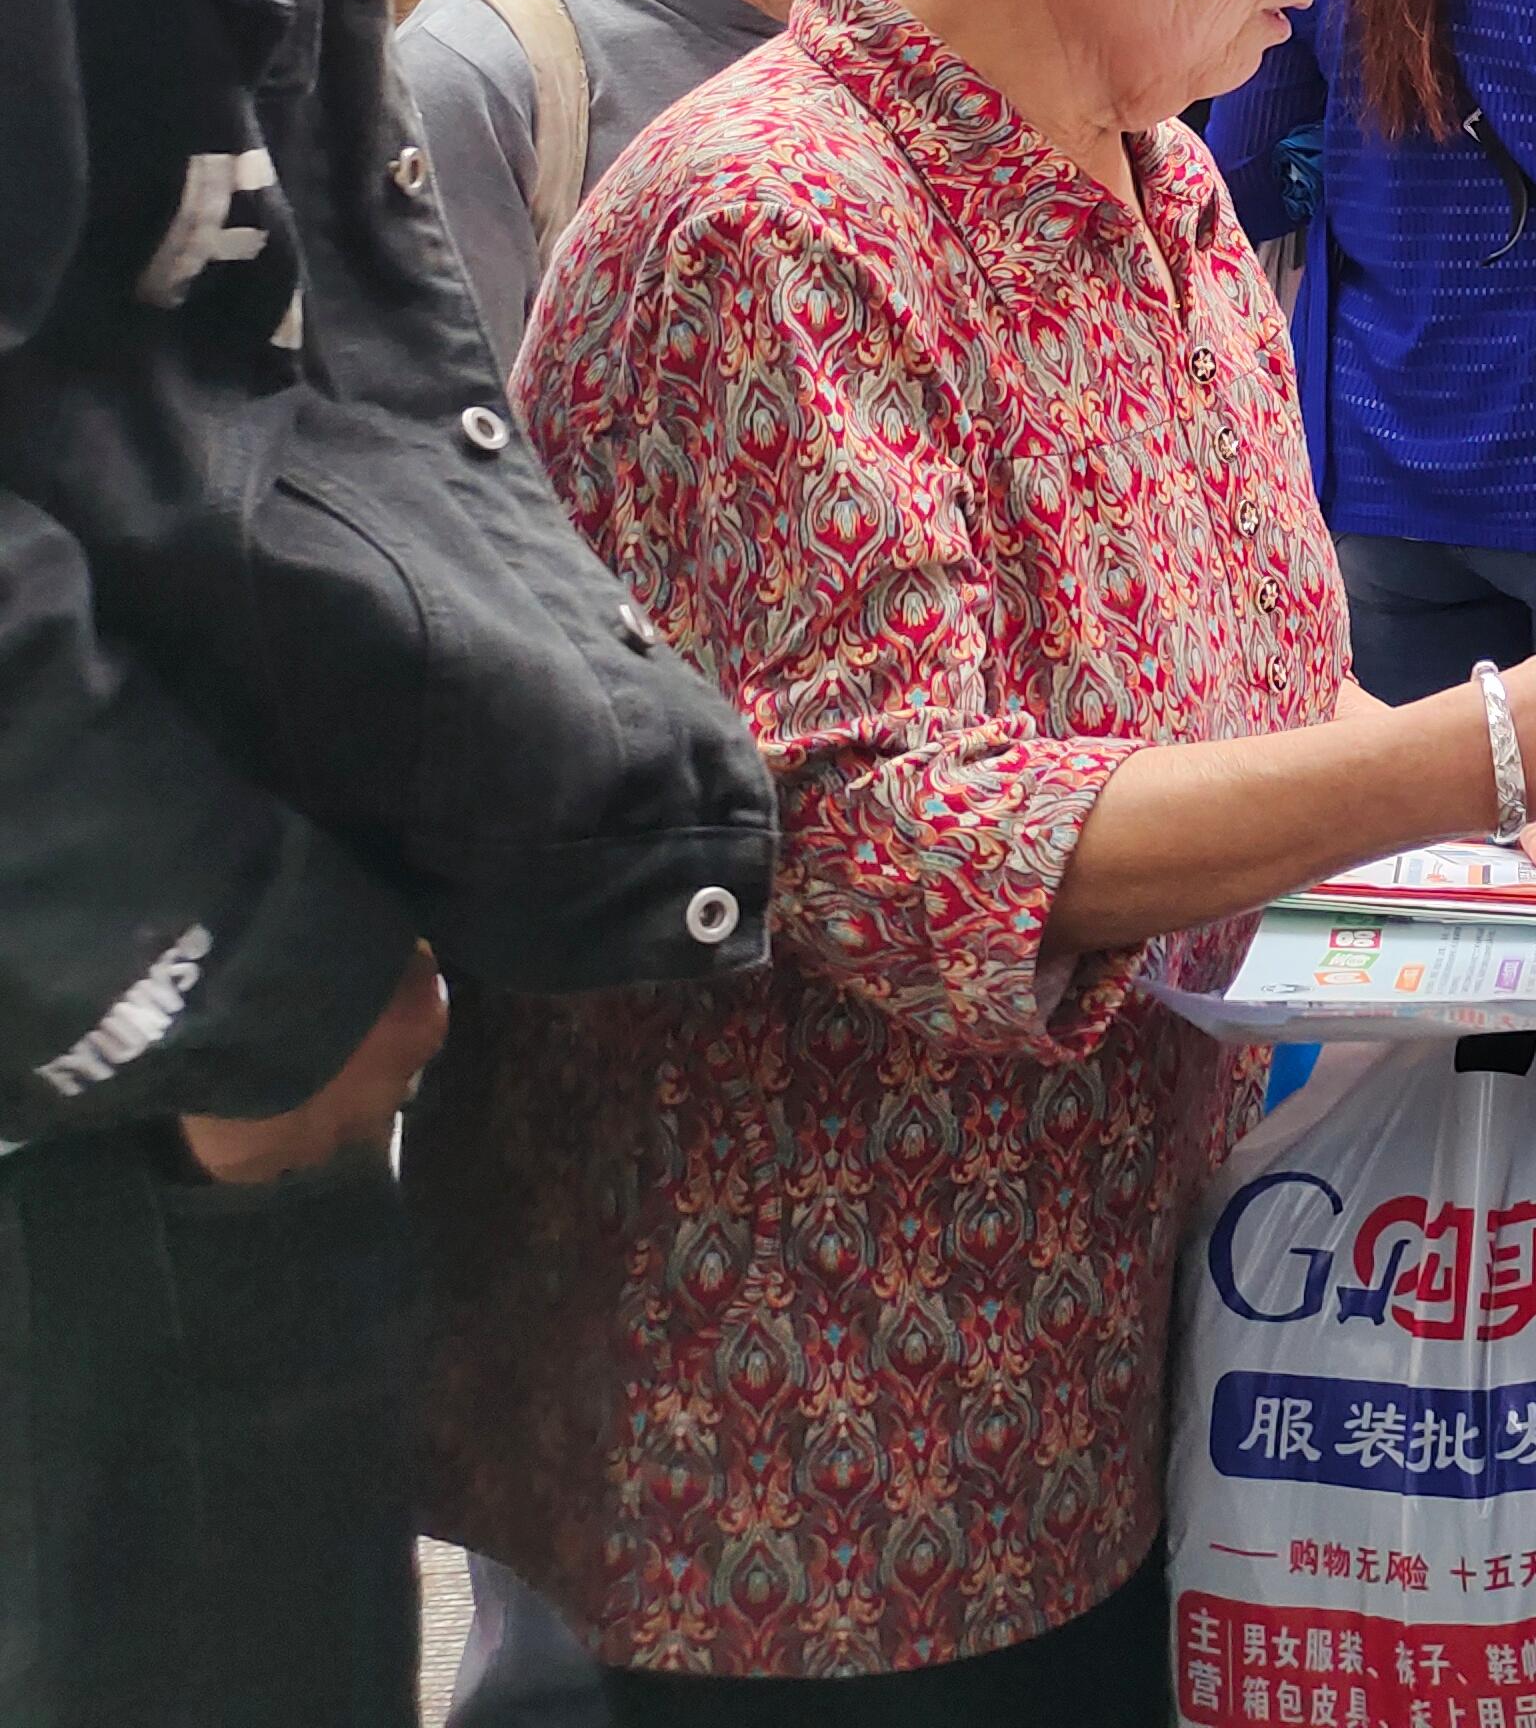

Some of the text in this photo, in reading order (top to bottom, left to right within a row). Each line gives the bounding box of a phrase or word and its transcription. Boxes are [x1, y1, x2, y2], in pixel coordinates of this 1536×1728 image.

[1288, 1539, 1429, 1592] 购物无风险
